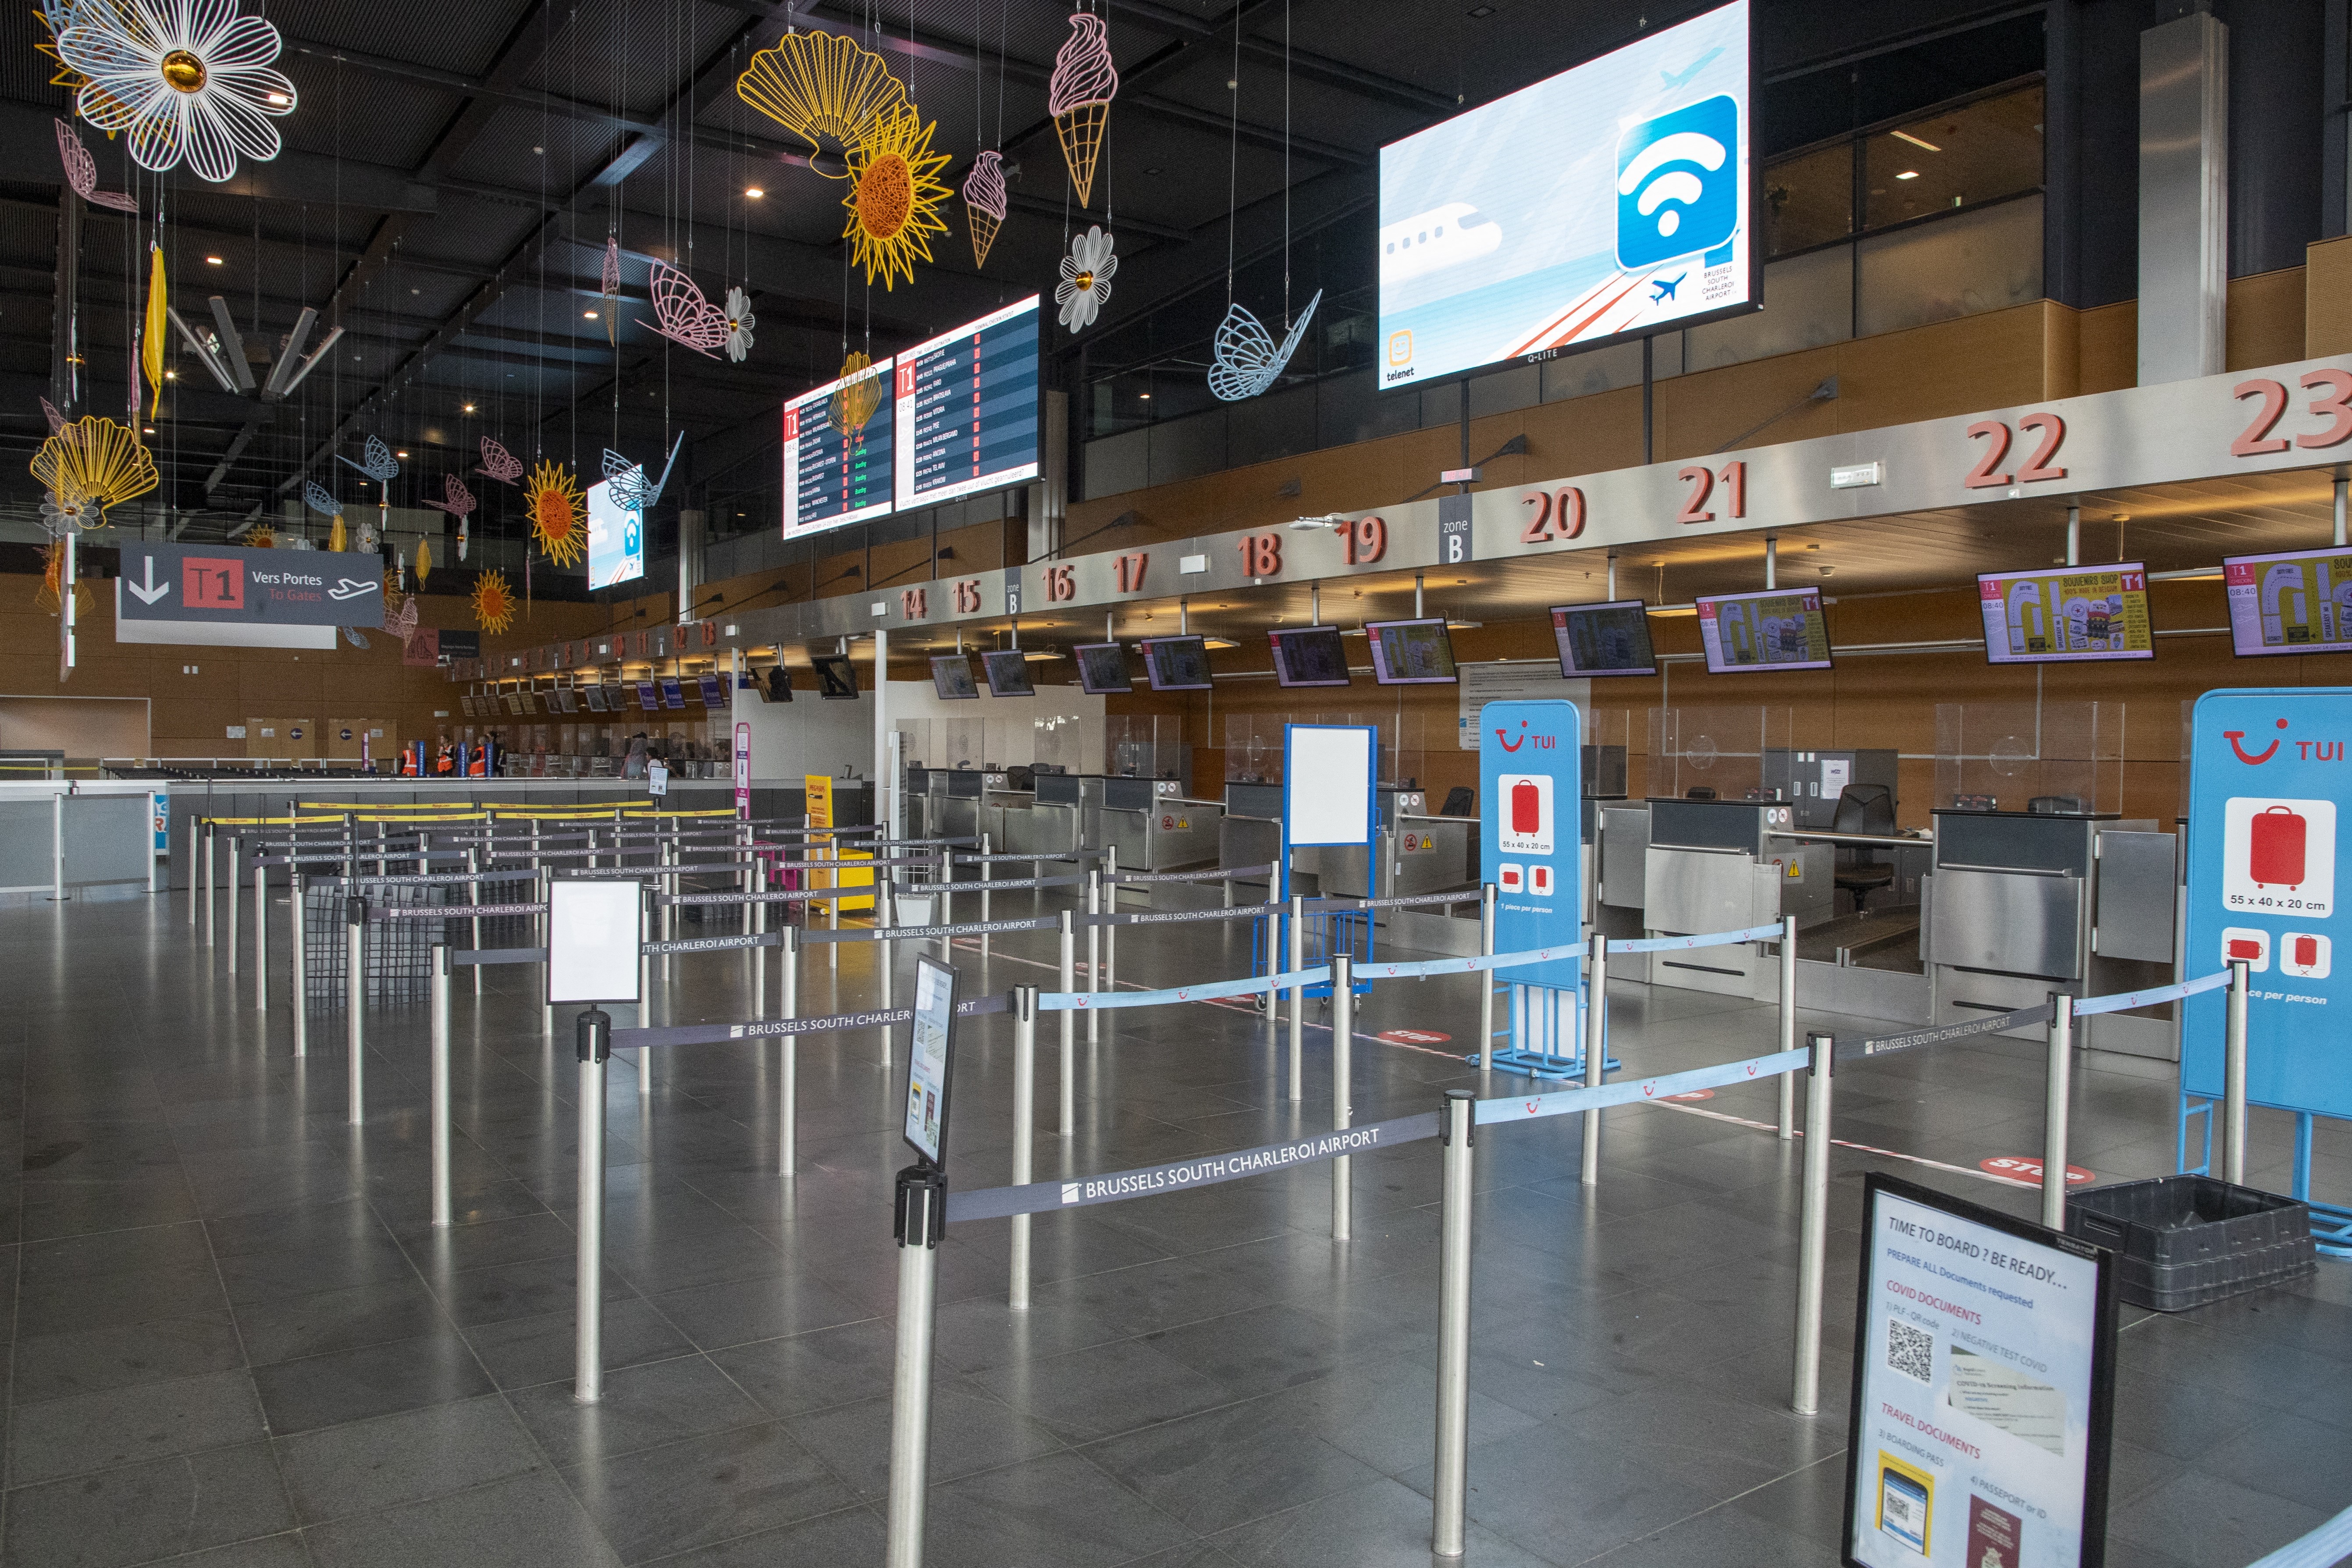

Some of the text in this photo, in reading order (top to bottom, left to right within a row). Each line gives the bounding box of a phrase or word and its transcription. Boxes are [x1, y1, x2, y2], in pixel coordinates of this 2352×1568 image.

[1704, 266, 1732, 278] BRUSSELS
[1708, 275, 1728, 285] SOUTH
[1702, 281, 1734, 294] CHARLEROI
[1706, 290, 1730, 301] AIRPORT
[1528, 348, 1557, 363] Q-LITE
[899, 365, 914, 393] T1
[1387, 367, 1414, 381] telenet
[786, 412, 798, 436] T1
[2231, 369, 2352, 457] 23
[1965, 412, 2068, 489] 22
[1677, 461, 1747, 524] 21
[1444, 519, 1468, 533] zone
[1520, 487, 1587, 544] 20
[1335, 516, 1388, 565] 19
[1449, 535, 1462, 563] B
[1238, 533, 1281, 576] 18
[253, 571, 322, 586] Vers Portes
[1113, 553, 1149, 593] 17
[2063, 574, 2119, 587] SOUVENIRS SHOP
[2232, 565, 2247, 576] T1
[189, 568, 235, 601] T1
[1007, 584, 1019, 593] zone
[1041, 565, 1075, 602] 16
[1985, 581, 1996, 591] T1
[2122, 573, 2144, 591] T1
[269, 589, 322, 602] To Gates
[900, 588, 928, 620] 14
[952, 580, 981, 613] 15
[1010, 594, 1017, 614] B
[1803, 597, 1819, 611] T1
[1532, 736, 1556, 749] TUI
[2295, 741, 2344, 761] TUI
[477, 906, 524, 914] CHARLEROI
[1199, 909, 1236, 919] CHARLEROI
[1238, 907, 1265, 915] AIRPORT
[2231, 896, 2244, 904] 55
[2259, 897, 2272, 907] 40
[2288, 899, 2302, 909] 20
[2307, 902, 2325, 910] cm
[885, 921, 1037, 938] BRUSSELS SOUTH CHARLEROI AIRPORT
[662, 940, 717, 952] CHARLEROI
[719, 936, 760, 947] AIRPORT
[2264, 991, 2285, 1001] per
[2286, 992, 2327, 1005] person
[748, 1010, 913, 1036] BRUSSELS SOUTH CHARLER
[1387, 1030, 1441, 1043] STOP
[1875, 1017, 2011, 1052] BRUSSELS SOUTH CHARLEROI AIRPORT
[1086, 1128, 1380, 1199] BRUSSELS SOUTH CHARLEROI AIRPORT
[1889, 1216, 1916, 1237] TIME
[1919, 1227, 1935, 1243] TO
[1937, 1233, 1980, 1258] BOARD
[1991, 1252, 2007, 1268] BE
[1886, 1248, 2034, 1309] PREPARE ALL Documents requested
[1886, 1279, 1982, 1326] COVID DOCUMENTS
[1894, 1304, 1905, 1315] PLF
[1910, 1311, 1921, 1321] QR
[1922, 1315, 1939, 1330] code
[1960, 1331, 1999, 1355] NEGATIVE
[2000, 1346, 2019, 1361] TEST
[2020, 1355, 2047, 1373] COVID
[1882, 1402, 1981, 1459] TRAVEL DOCUMENTS
[1886, 1432, 1925, 1458] BOARDING
[1926, 1451, 1944, 1467] PASS
[1979, 1479, 2026, 1509] PASSEPORT
[2026, 1504, 2036, 1515] or
[2036, 1508, 2047, 1519] ID
